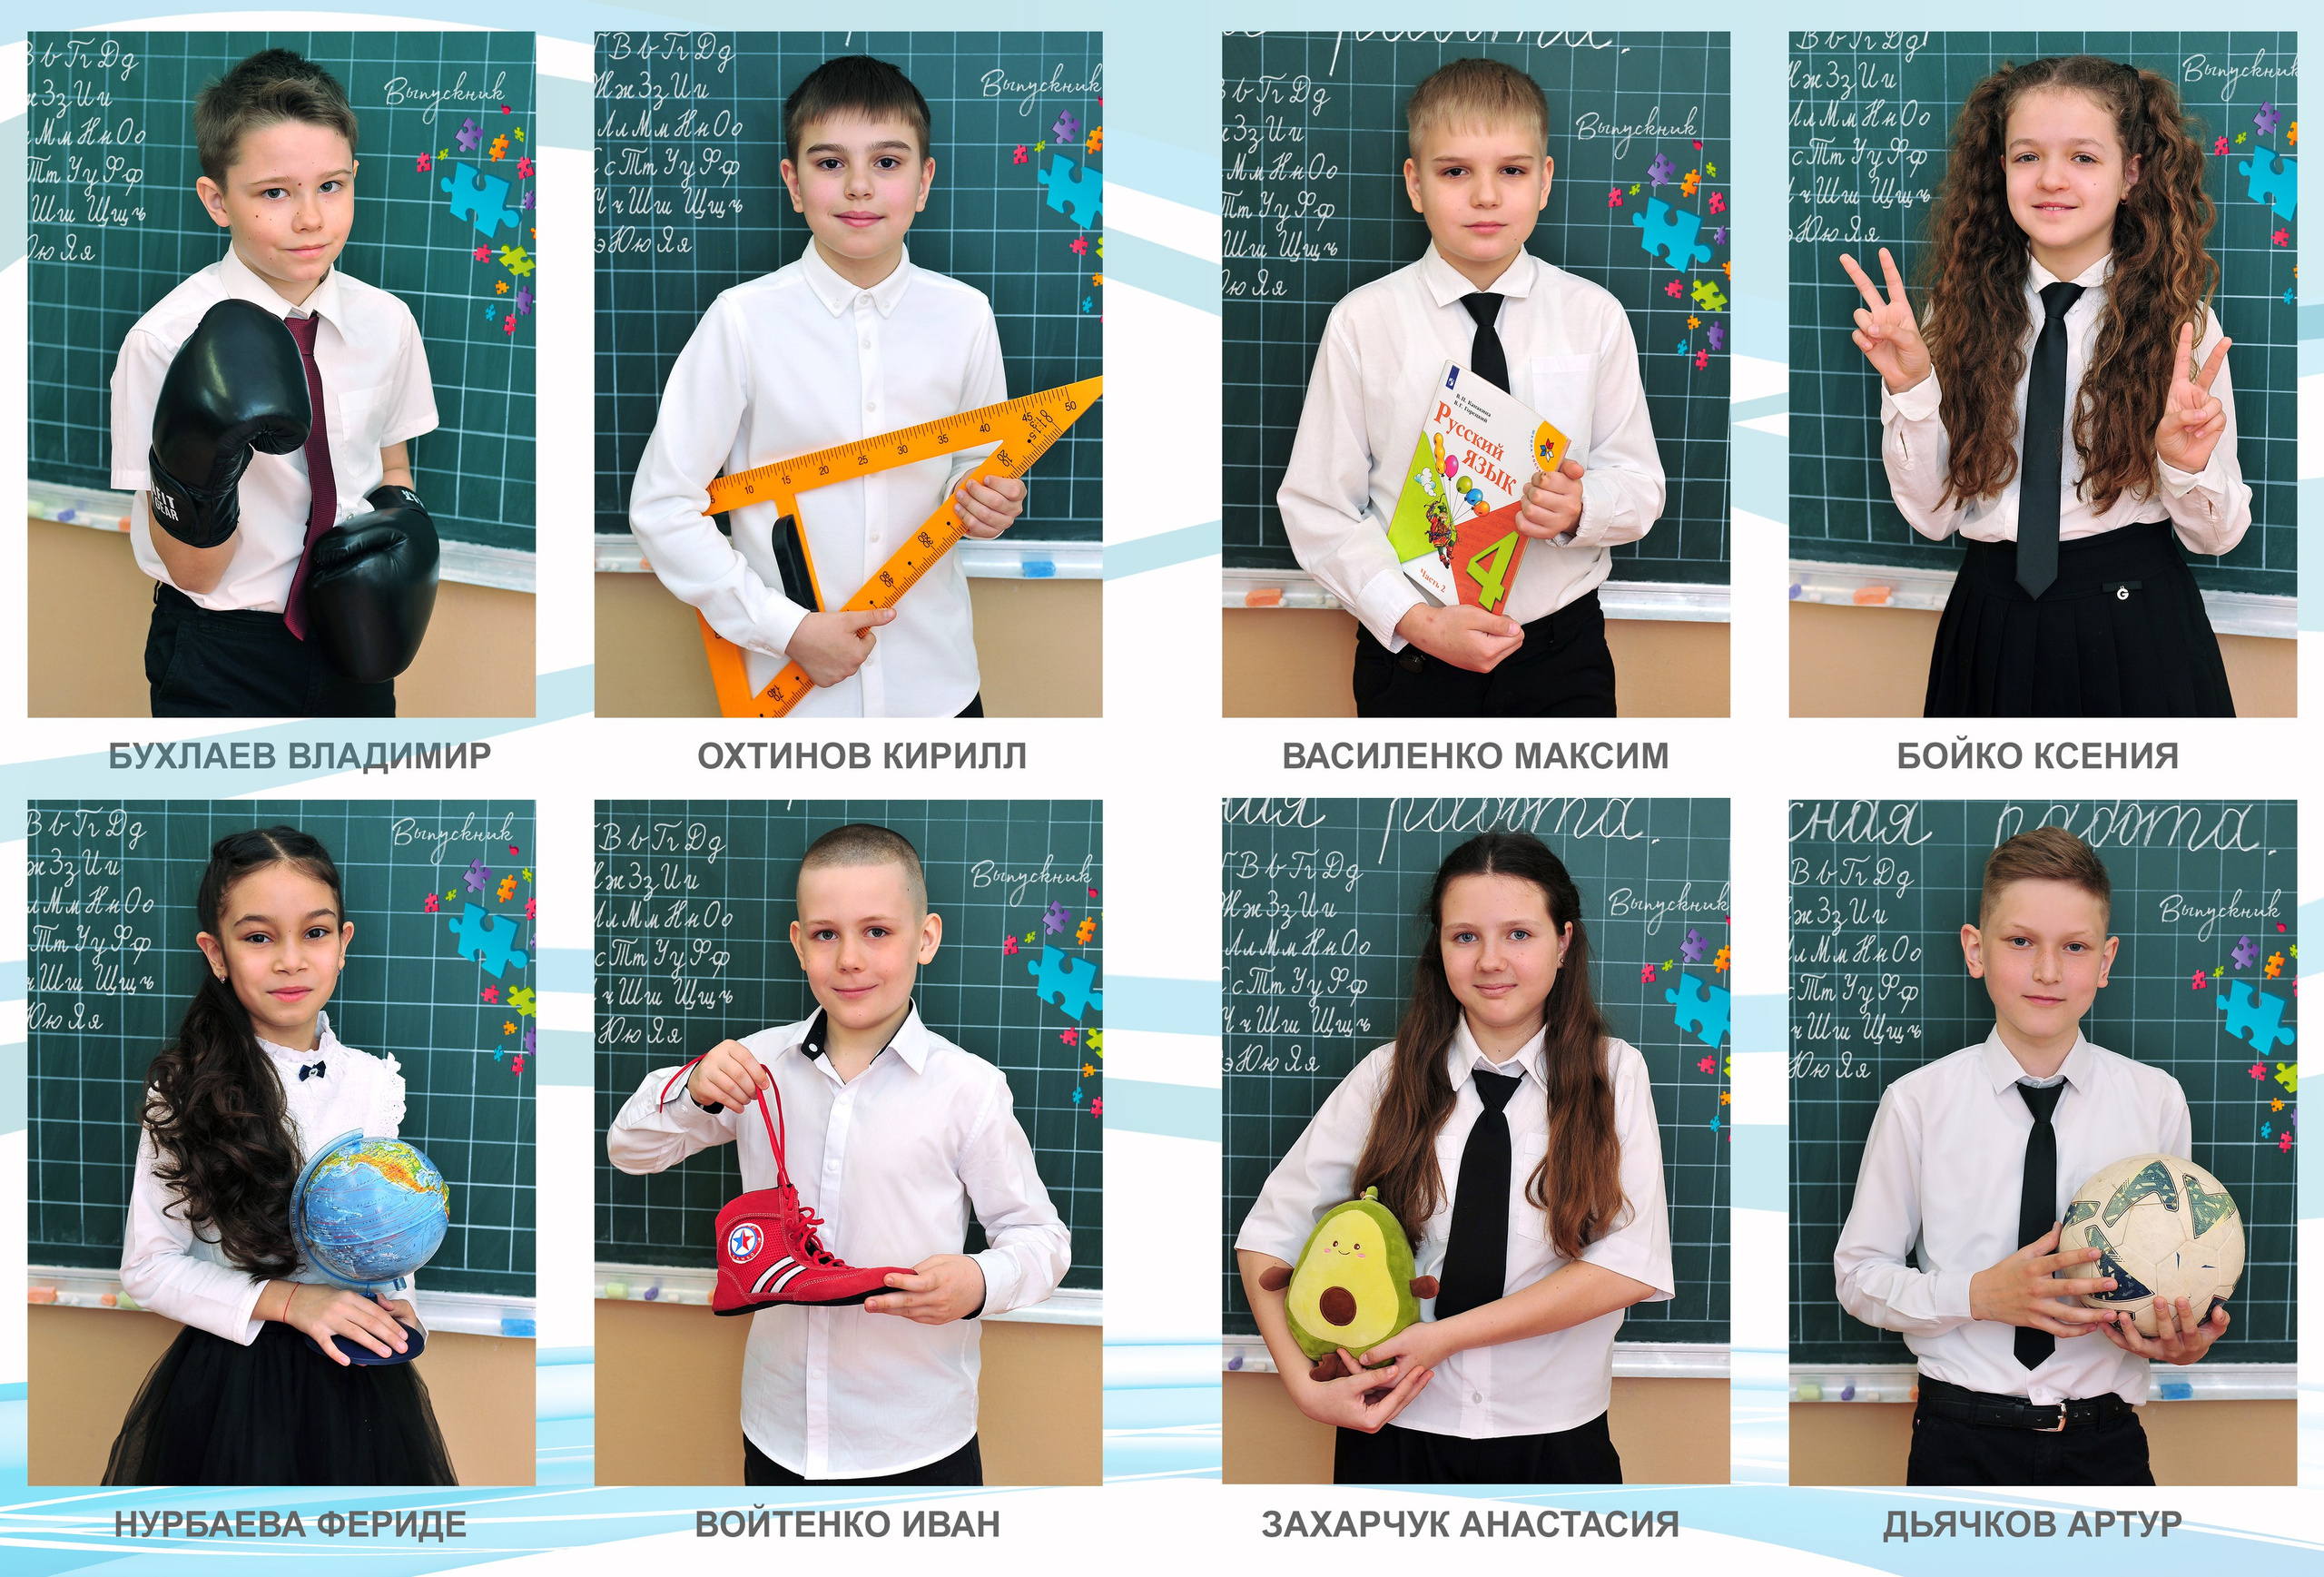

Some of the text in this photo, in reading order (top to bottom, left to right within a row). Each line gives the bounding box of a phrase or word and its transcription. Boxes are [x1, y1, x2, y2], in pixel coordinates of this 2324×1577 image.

[384, 71, 506, 125] Выпускник
[980, 63, 1102, 117] Выпускник
[1576, 106, 1698, 160] Выпускник
[744, 485, 754, 494] 10
[782, 476, 792, 485] 15
[819, 466, 829, 475] 20
[858, 456, 868, 465] 25
[897, 445, 908, 455] 30
[938, 434, 949, 444] 35
[980, 423, 990, 433] 40
[1022, 412, 1033, 422] 45
[1065, 401, 1077, 411] 50
[1433, 400, 1505, 461] Русский
[1420, 567, 1439, 588] Часть
[1466, 530, 1520, 612] 4
[392, 812, 514, 865] Выпускник
[971, 854, 1093, 907] Выпускник
[1609, 882, 1730, 935] Выпускник
[2160, 889, 2281, 941] Выпускник
